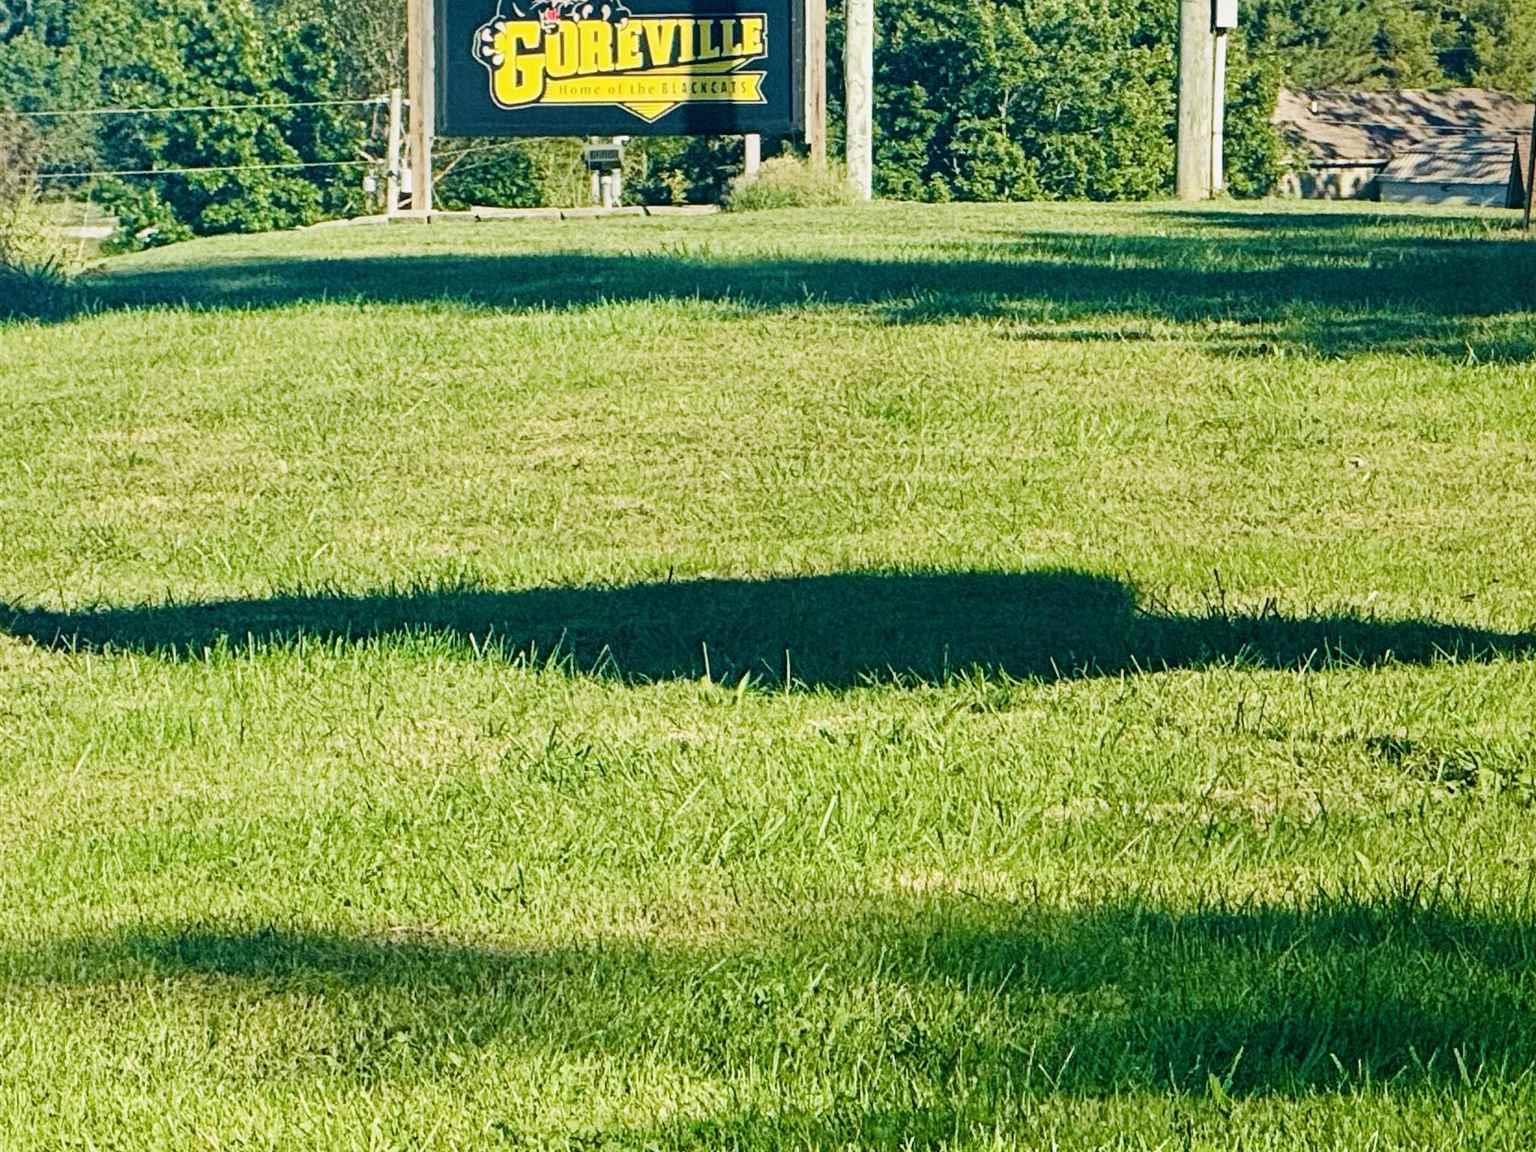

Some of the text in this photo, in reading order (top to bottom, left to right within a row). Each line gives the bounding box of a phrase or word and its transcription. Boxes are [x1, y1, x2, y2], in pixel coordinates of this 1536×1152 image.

[498, 17, 763, 105] GOREVILLE
[559, 80, 747, 96] Home of the BLACKCATS
